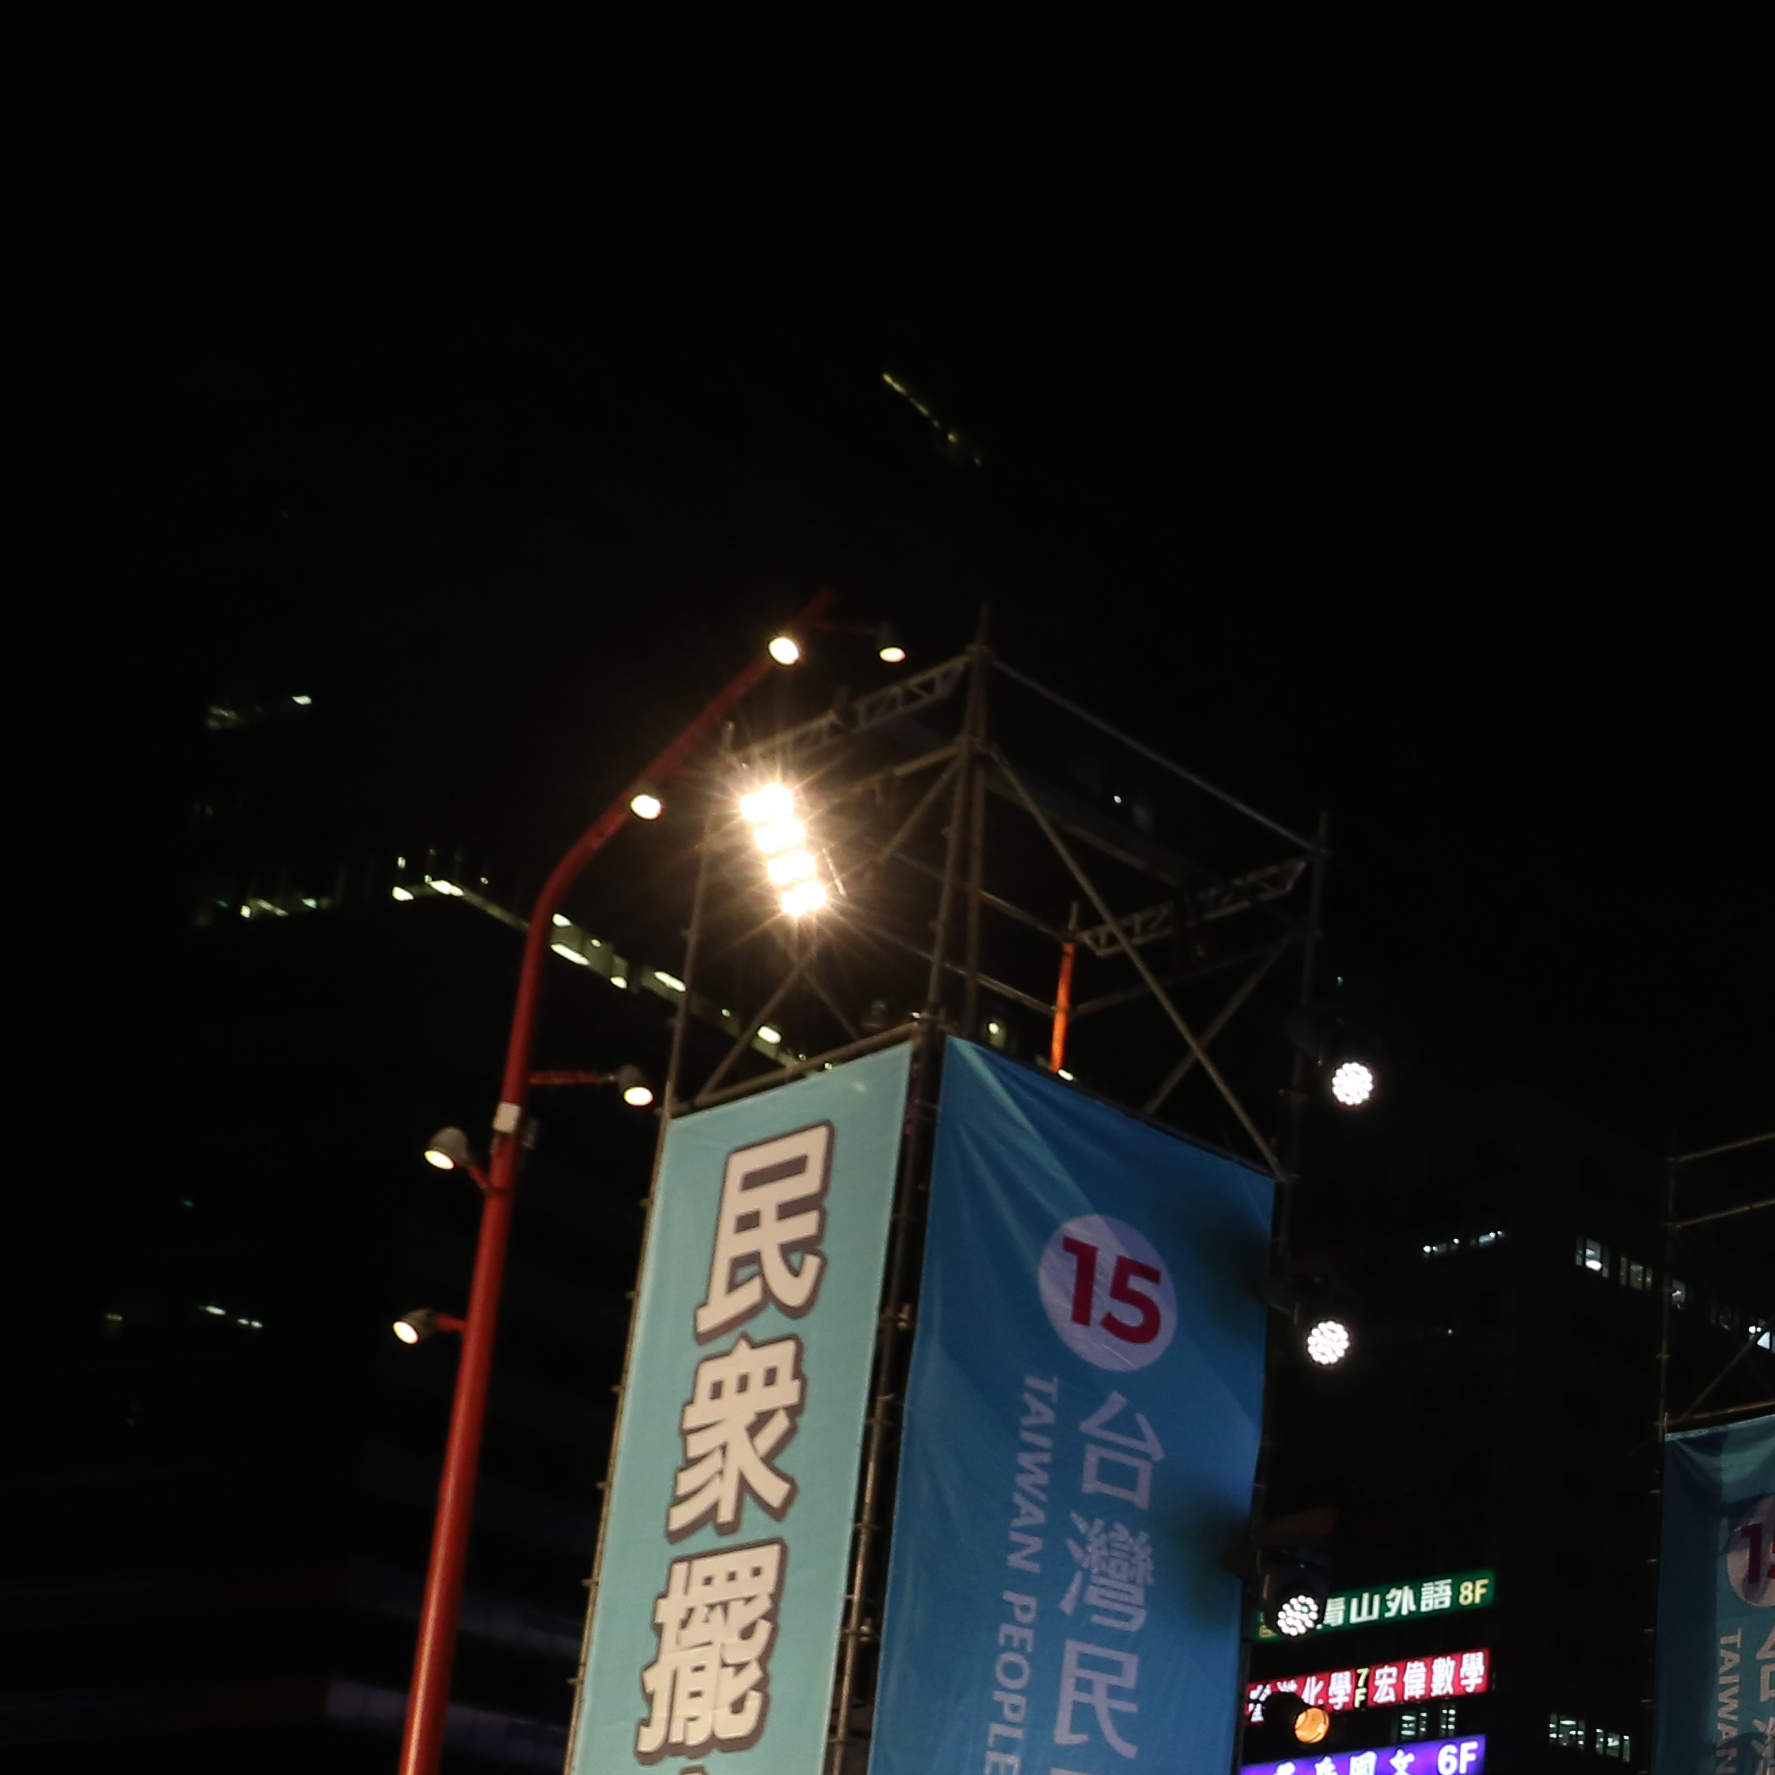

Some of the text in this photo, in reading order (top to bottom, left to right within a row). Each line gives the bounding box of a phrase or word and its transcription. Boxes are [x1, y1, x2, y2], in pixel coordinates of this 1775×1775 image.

[1060, 1235, 1164, 1346] 15
[998, 1372, 1060, 1582] TAIWAN
[1458, 1579, 1490, 1606] 8F
[1373, 1651, 1485, 1705] 宏偉數學
